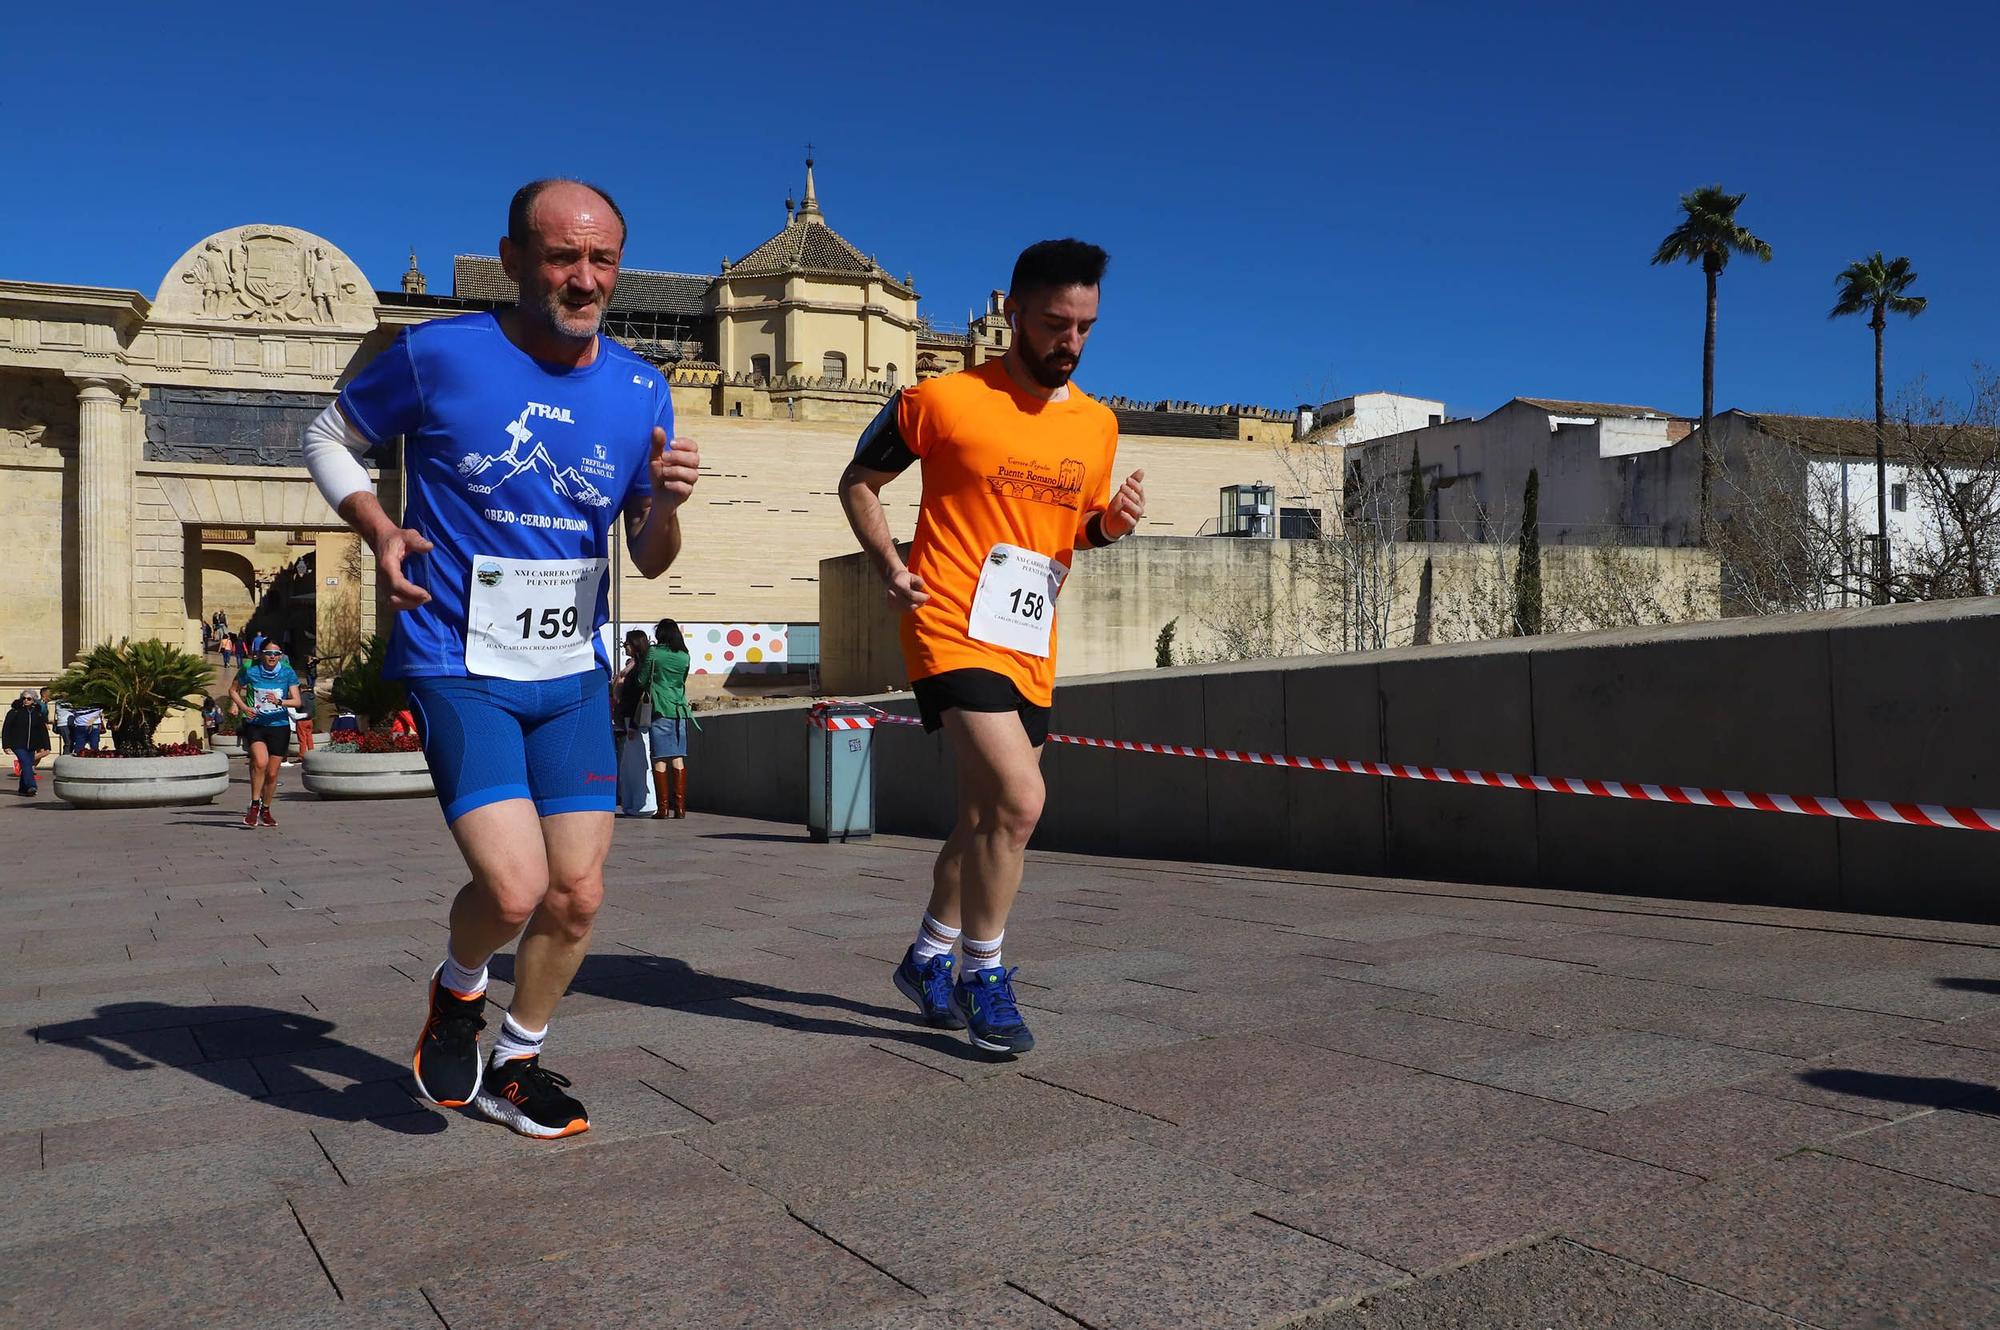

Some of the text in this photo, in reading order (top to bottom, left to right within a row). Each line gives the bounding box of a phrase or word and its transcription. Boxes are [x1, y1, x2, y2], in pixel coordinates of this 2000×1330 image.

[528, 401, 575, 424] TRAIL
[581, 457, 615, 471] TREFILADOS
[998, 466, 1057, 485] Puente Romano
[467, 483, 492, 495] 2020
[484, 508, 515, 524] OBEJO
[520, 513, 551, 528] CERRO
[552, 517, 588, 532] MURIANO
[531, 569, 570, 577] CARRERA
[1009, 588, 1044, 620] 158
[516, 606, 578, 639] 159
